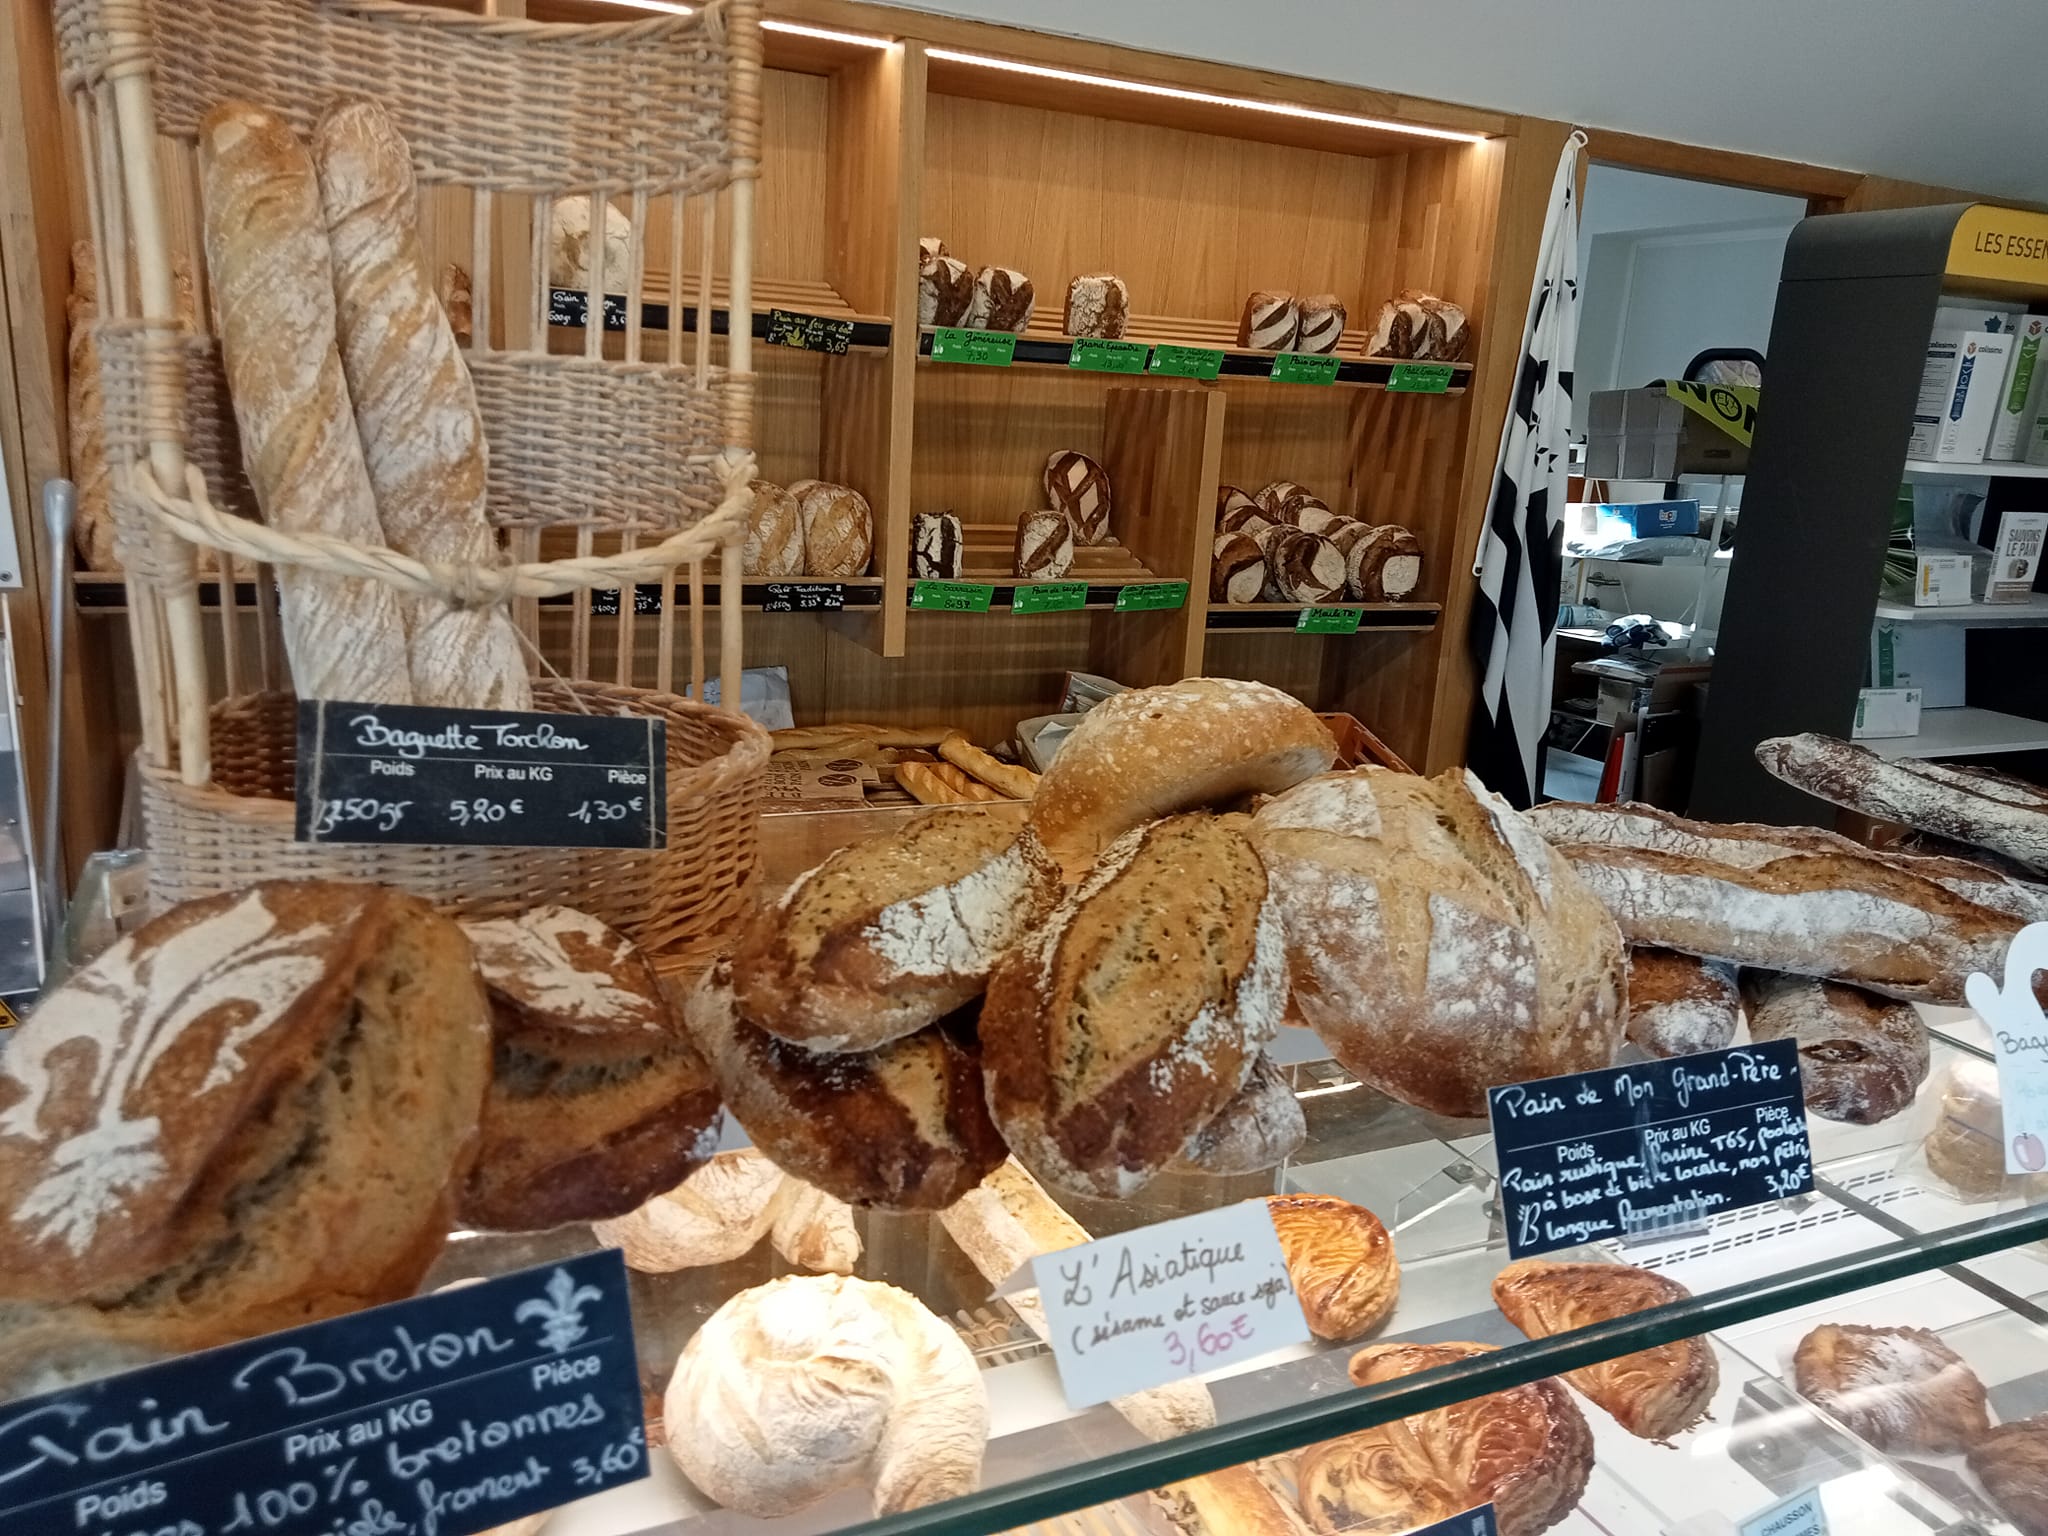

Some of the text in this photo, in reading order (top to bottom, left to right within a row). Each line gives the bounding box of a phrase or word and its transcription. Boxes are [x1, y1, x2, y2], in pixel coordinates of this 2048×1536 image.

[1975, 231, 2003, 254] LES
[808, 318, 824, 329] feu
[2006, 542, 2038, 557] LE PAIN
[2009, 528, 2042, 542] SAUVONS
[350, 714, 483, 759] Baguette
[371, 760, 647, 785] Poids Prix au KG Pièce
[449, 797, 525, 827] 5,20€
[568, 797, 643, 824] 1,30€
[1495, 1052, 1782, 1119] Pain de Mon Grand-Père
[1556, 1106, 1790, 1164] Poids Prix au KG Pièce
[1502, 1167, 1554, 1193] Pain
[1542, 1191, 1558, 1212] à
[1560, 1187, 1602, 1209] base
[1604, 1179, 1625, 1197] de
[1674, 1158, 1738, 1182] locale,
[1739, 1155, 1771, 1170] non
[1764, 1163, 1811, 1198] 3,20€
[1545, 1219, 1616, 1242] longue
[1173, 1293, 1197, 1321] et
[1200, 1291, 1246, 1316] sauce
[1163, 1313, 1255, 1374] 3,60€
[0, 1325, 517, 1484] Pain Breton
[76, 1480, 169, 1528] Poids
[284, 1429, 344, 1464] Prix
[347, 1420, 385, 1447] au
[392, 1398, 434, 1434] KG
[531, 1354, 601, 1391] Pièce
[220, 1392, 606, 1534] 100% bretonnes
[416, 1455, 551, 1536] froment
[570, 1425, 646, 1485] 3,60€
